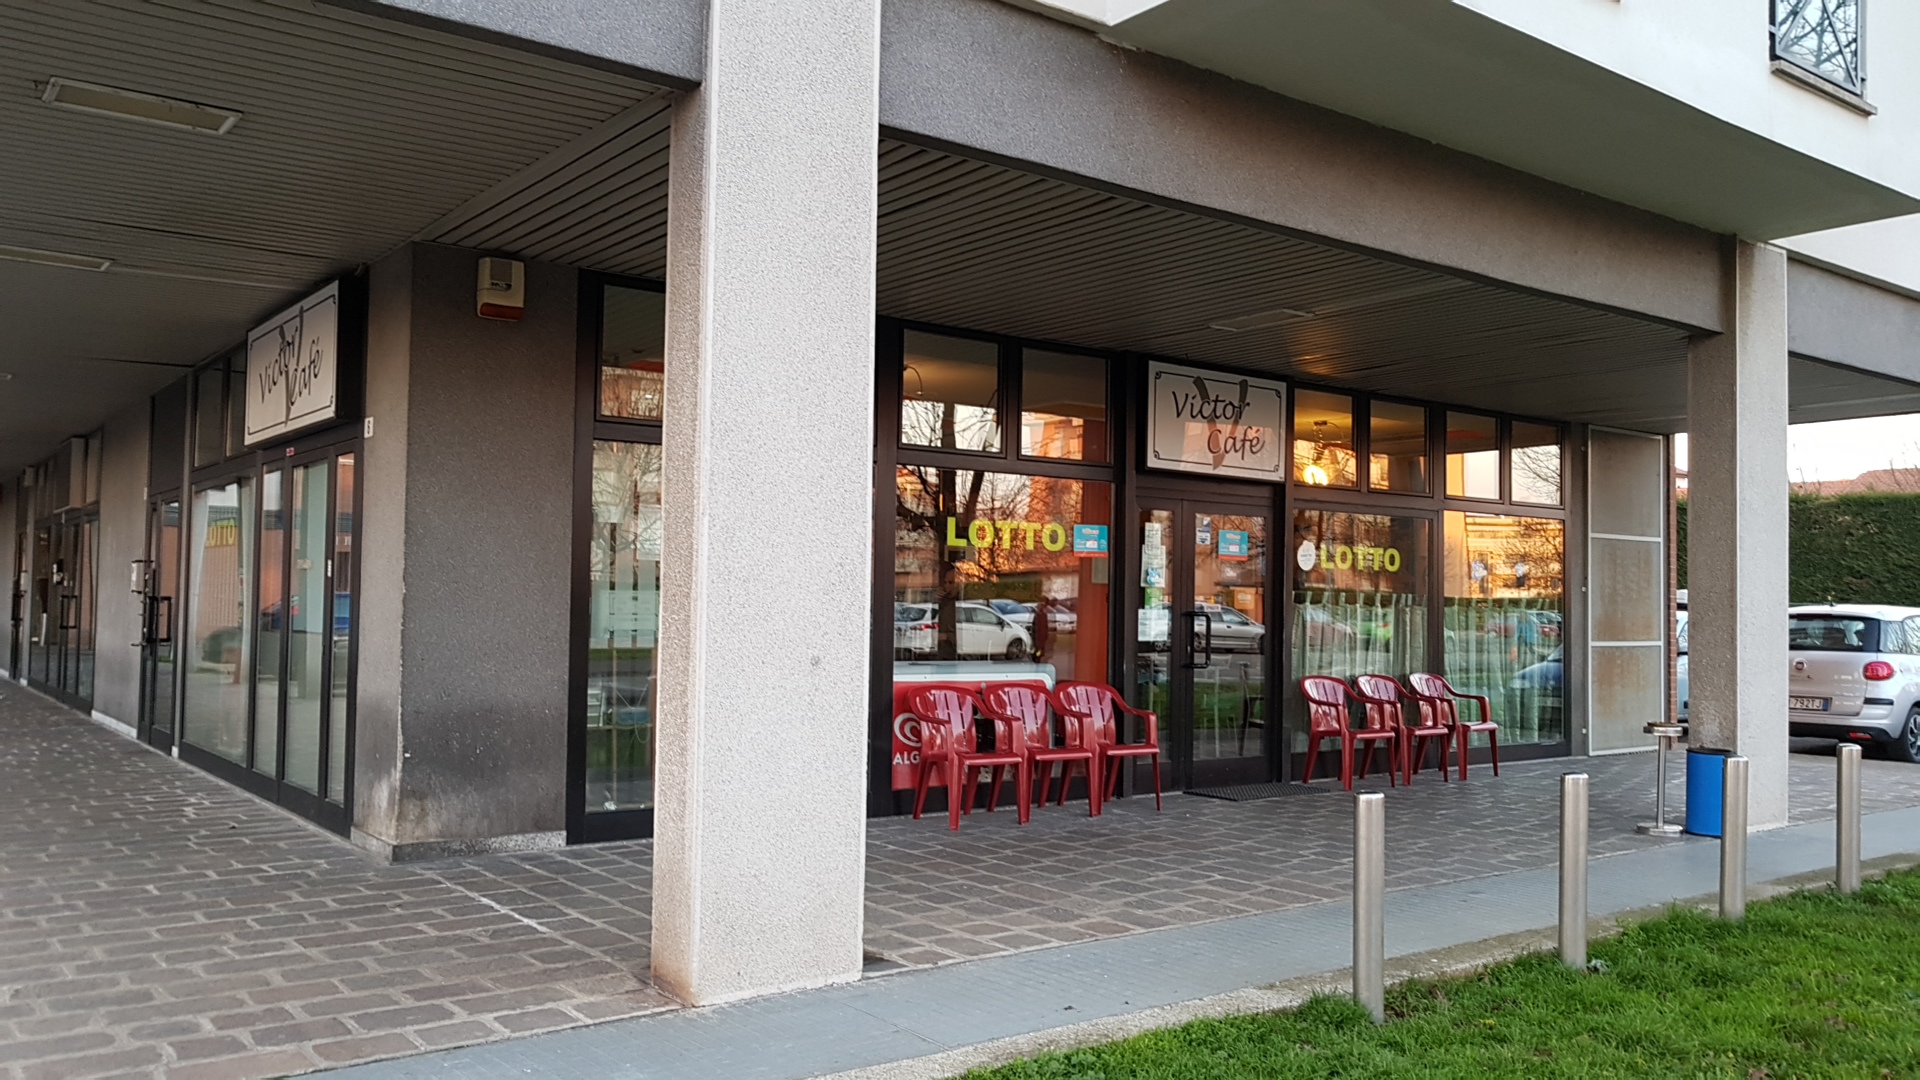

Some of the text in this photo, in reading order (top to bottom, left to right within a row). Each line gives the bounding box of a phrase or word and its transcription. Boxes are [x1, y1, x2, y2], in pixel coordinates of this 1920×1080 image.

[259, 325, 299, 404] Victor
[289, 336, 324, 407] Café
[1172, 391, 1250, 420] Victor
[1207, 426, 1266, 461] Café
[946, 516, 1066, 552] LOTTO
[1320, 543, 1401, 572] LOTTO
[892, 751, 920, 765] ALG
